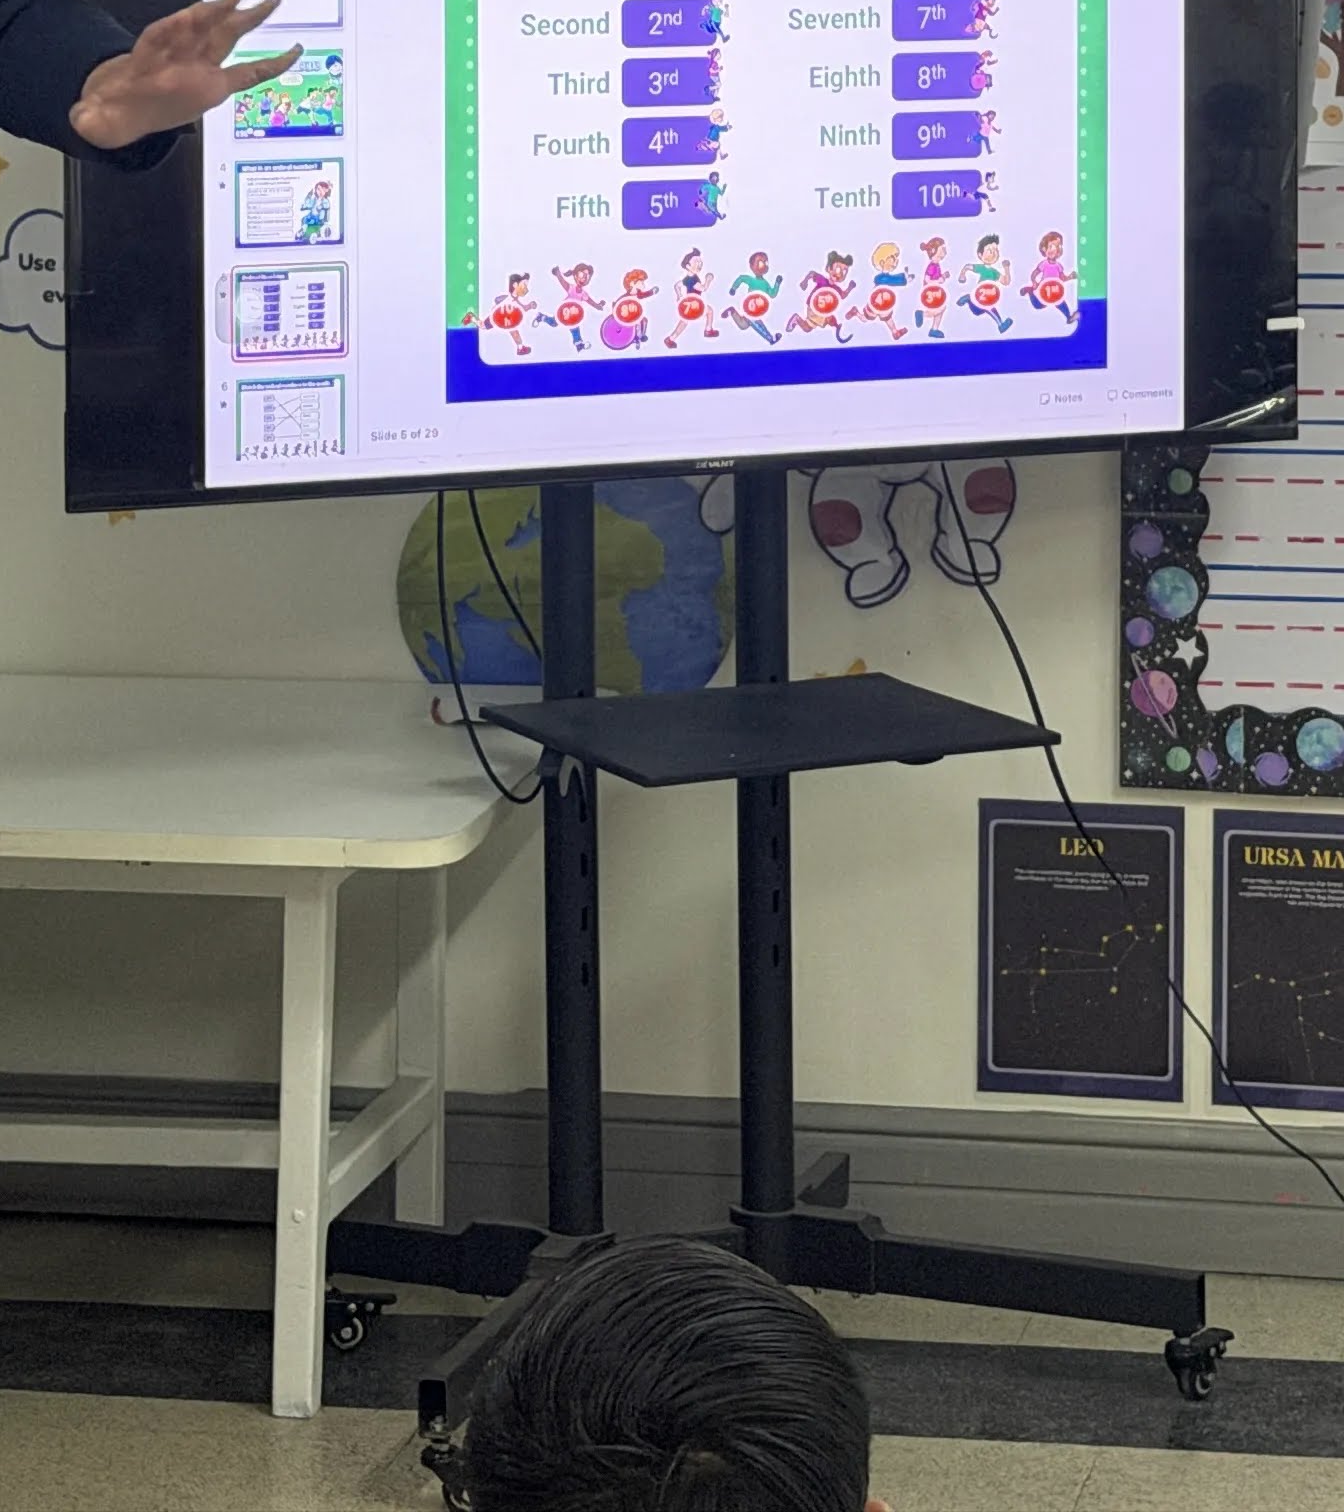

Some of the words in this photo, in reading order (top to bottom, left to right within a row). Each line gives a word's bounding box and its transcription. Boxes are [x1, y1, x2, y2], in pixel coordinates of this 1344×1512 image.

[520, 11, 610, 36] Second
[648, 8, 682, 35] 2nd
[787, 6, 881, 30] Seventh
[917, 3, 946, 30] 7th
[547, 71, 610, 95] Third
[648, 68, 679, 95] 3rd
[809, 64, 881, 93] Eighth
[917, 63, 946, 89] 8th
[532, 132, 610, 156] Fourth
[648, 128, 679, 155] 4th
[820, 123, 881, 147] Ninth
[917, 122, 946, 148] 9th
[556, 195, 610, 218] Fifth
[649, 192, 679, 217] 5th
[814, 185, 881, 208] Tenth
[918, 181, 961, 207] 10th
[18, 253, 57, 271] Use
[1055, 393, 1083, 403] Notes
[1122, 389, 1173, 400] Comments
[371, 429, 398, 442] Slide
[410, 428, 422, 439] of
[424, 427, 439, 439] 29
[1059, 836, 1105, 857] LEO
[1244, 845, 1305, 868] URSA
